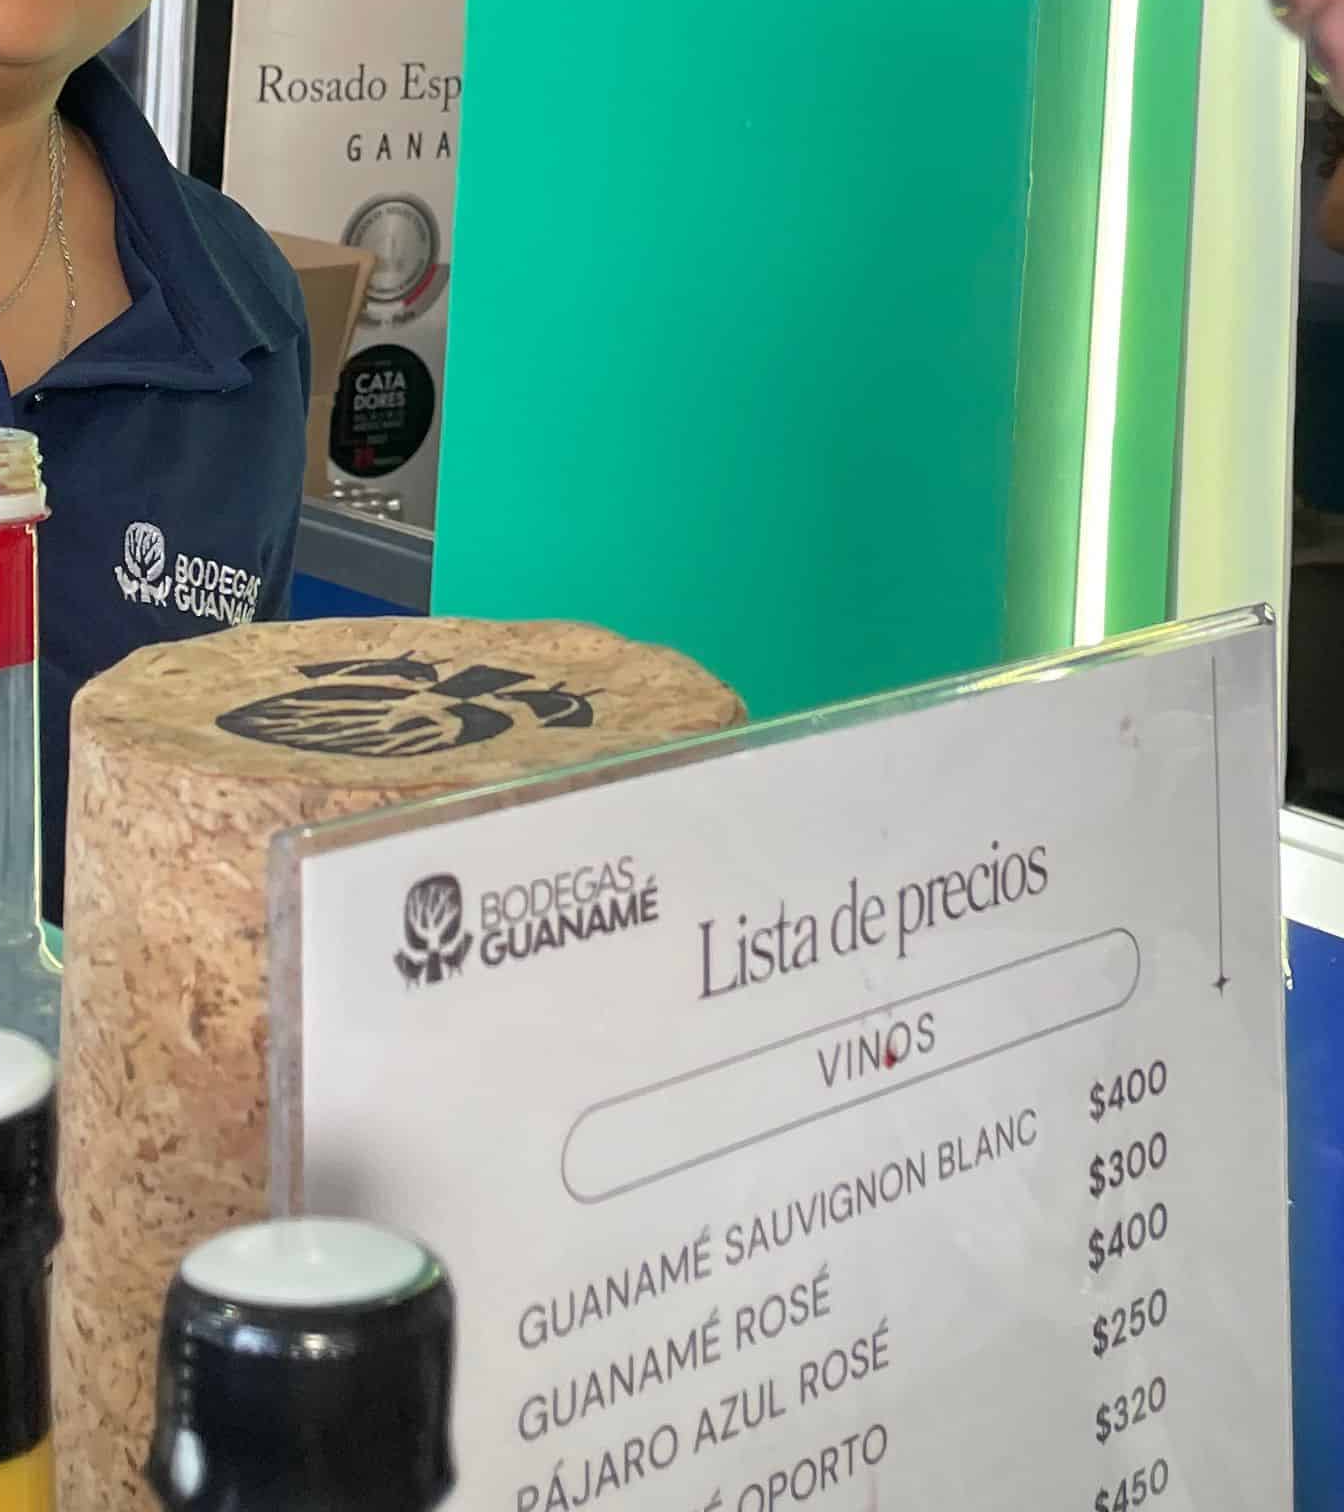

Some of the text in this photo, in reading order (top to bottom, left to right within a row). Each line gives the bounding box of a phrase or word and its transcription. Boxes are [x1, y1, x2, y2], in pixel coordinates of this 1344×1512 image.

[257, 62, 387, 104] Rosado
[353, 390, 406, 411] DORES
[355, 371, 407, 393] CATA
[480, 855, 634, 931] BODEGAS
[480, 874, 660, 967] GUANAMÉ
[698, 840, 1048, 1000] Lista de precios
[817, 1011, 936, 1089] VINOS
[518, 1059, 1167, 1350] GUANAMÉ SAUVIGNON BLANC $400
[517, 1131, 1167, 1442] GUANAMÉ ROSÉ $300
[516, 1202, 1168, 1512] PÁJARO AZUL ROSÉ $400
[737, 1288, 1168, 1512] OPORTO $250
[1095, 1375, 1167, 1446] $320
[1094, 1457, 1169, 1512] $450
